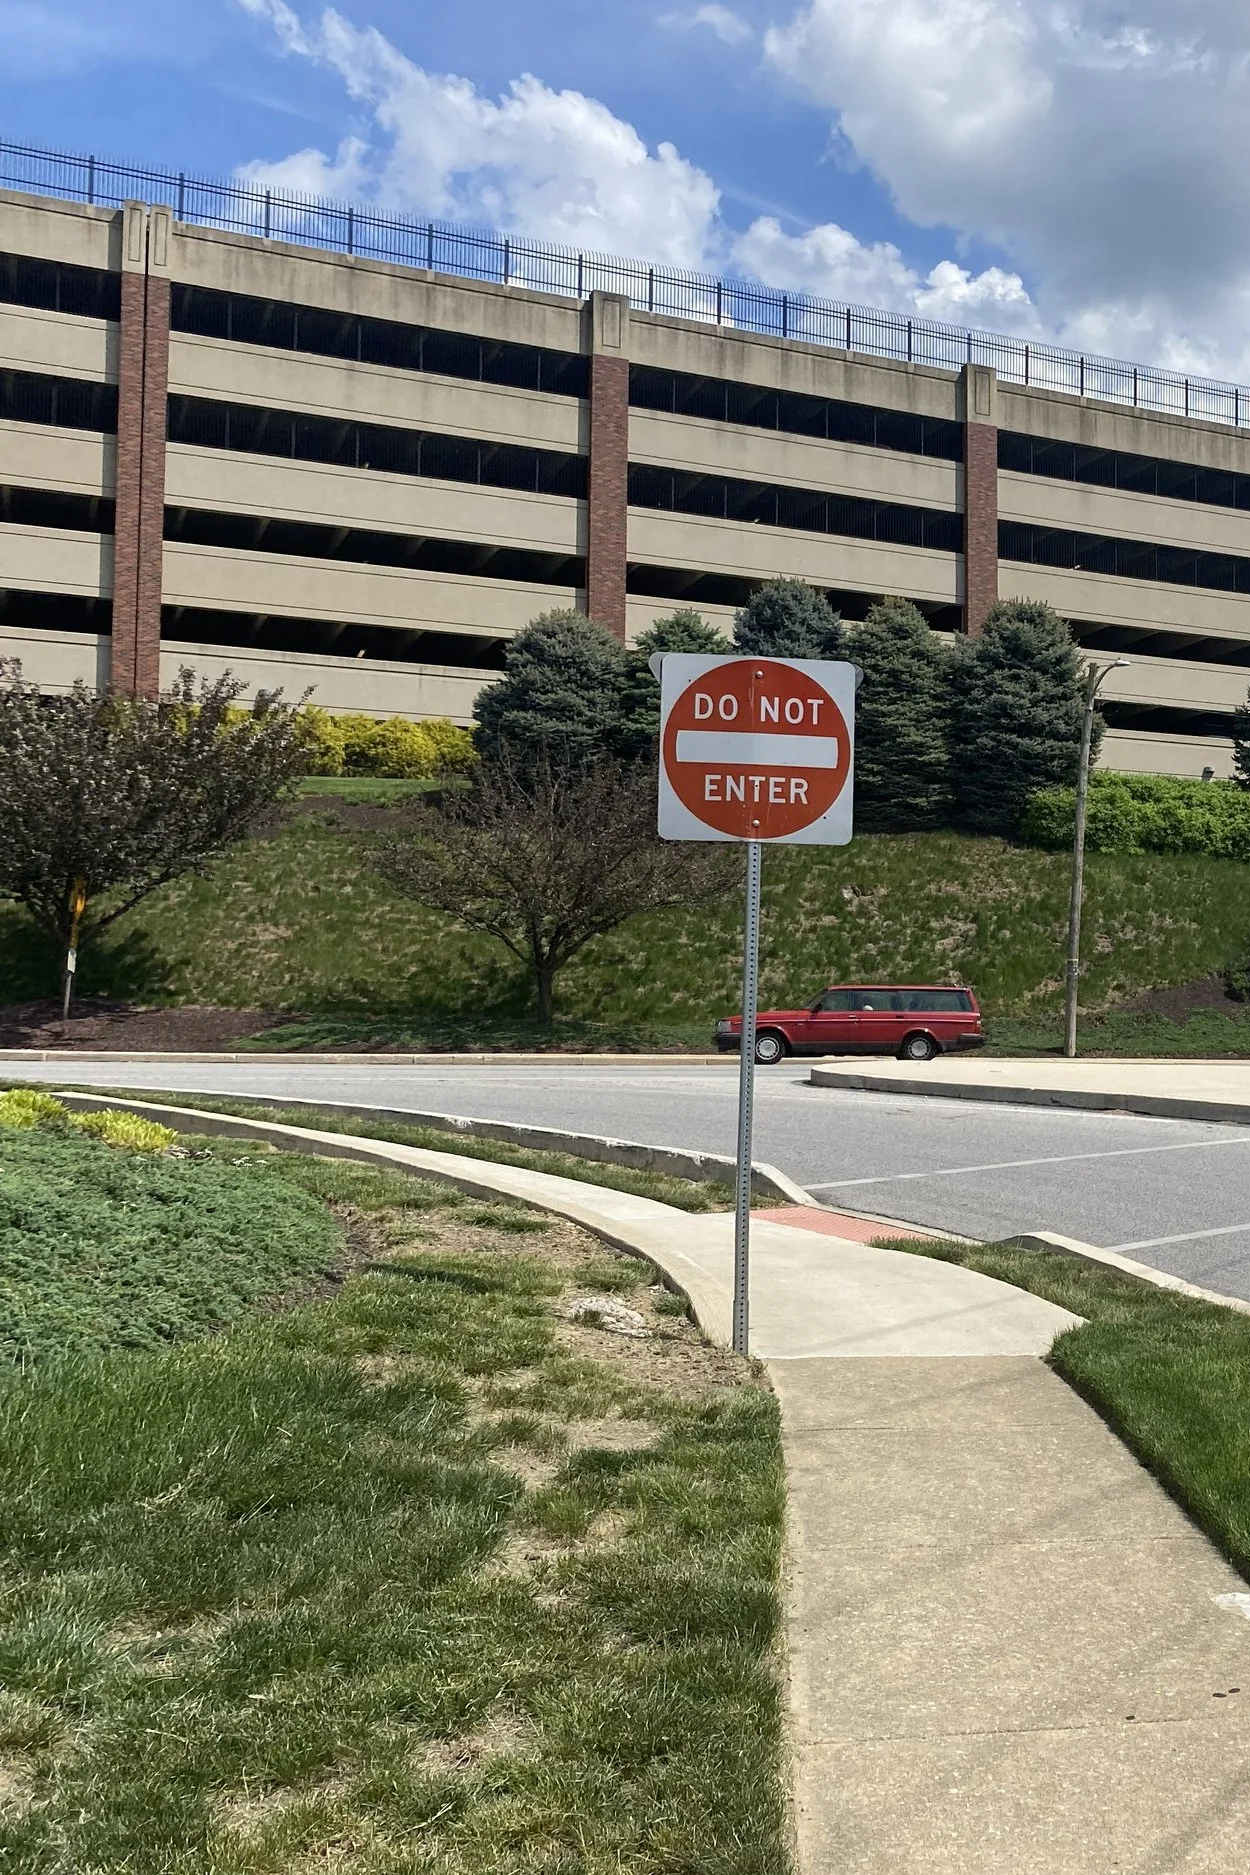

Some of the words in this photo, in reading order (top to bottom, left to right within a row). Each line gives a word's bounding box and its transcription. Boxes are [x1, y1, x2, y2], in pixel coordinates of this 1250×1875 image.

[694, 693, 739, 721] DO
[760, 696, 824, 725] NOT
[704, 774, 809, 805] ENTER
